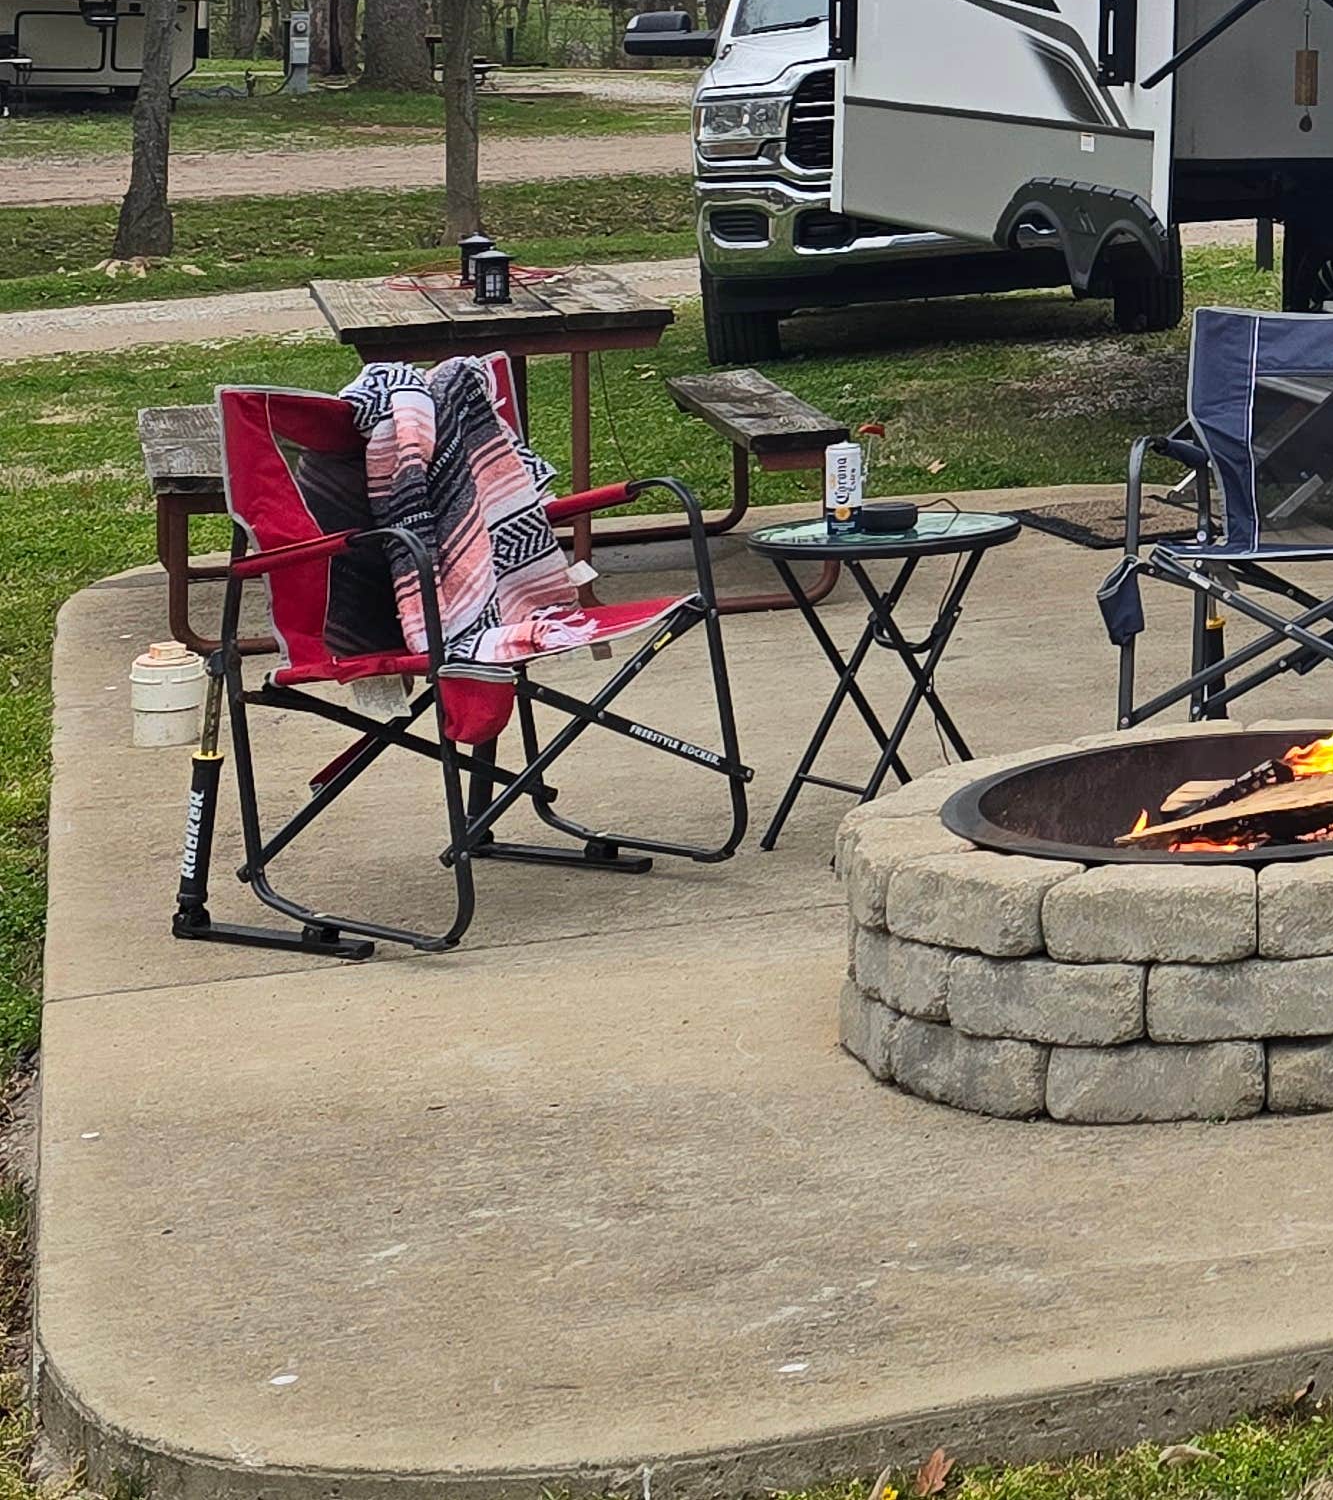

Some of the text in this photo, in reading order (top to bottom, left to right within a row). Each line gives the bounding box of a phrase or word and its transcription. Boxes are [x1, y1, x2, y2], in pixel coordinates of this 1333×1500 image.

[835, 457, 850, 505] Corona
[629, 723, 720, 766] FREESTYLE ROCKER
[181, 789, 205, 879] ROCKER
